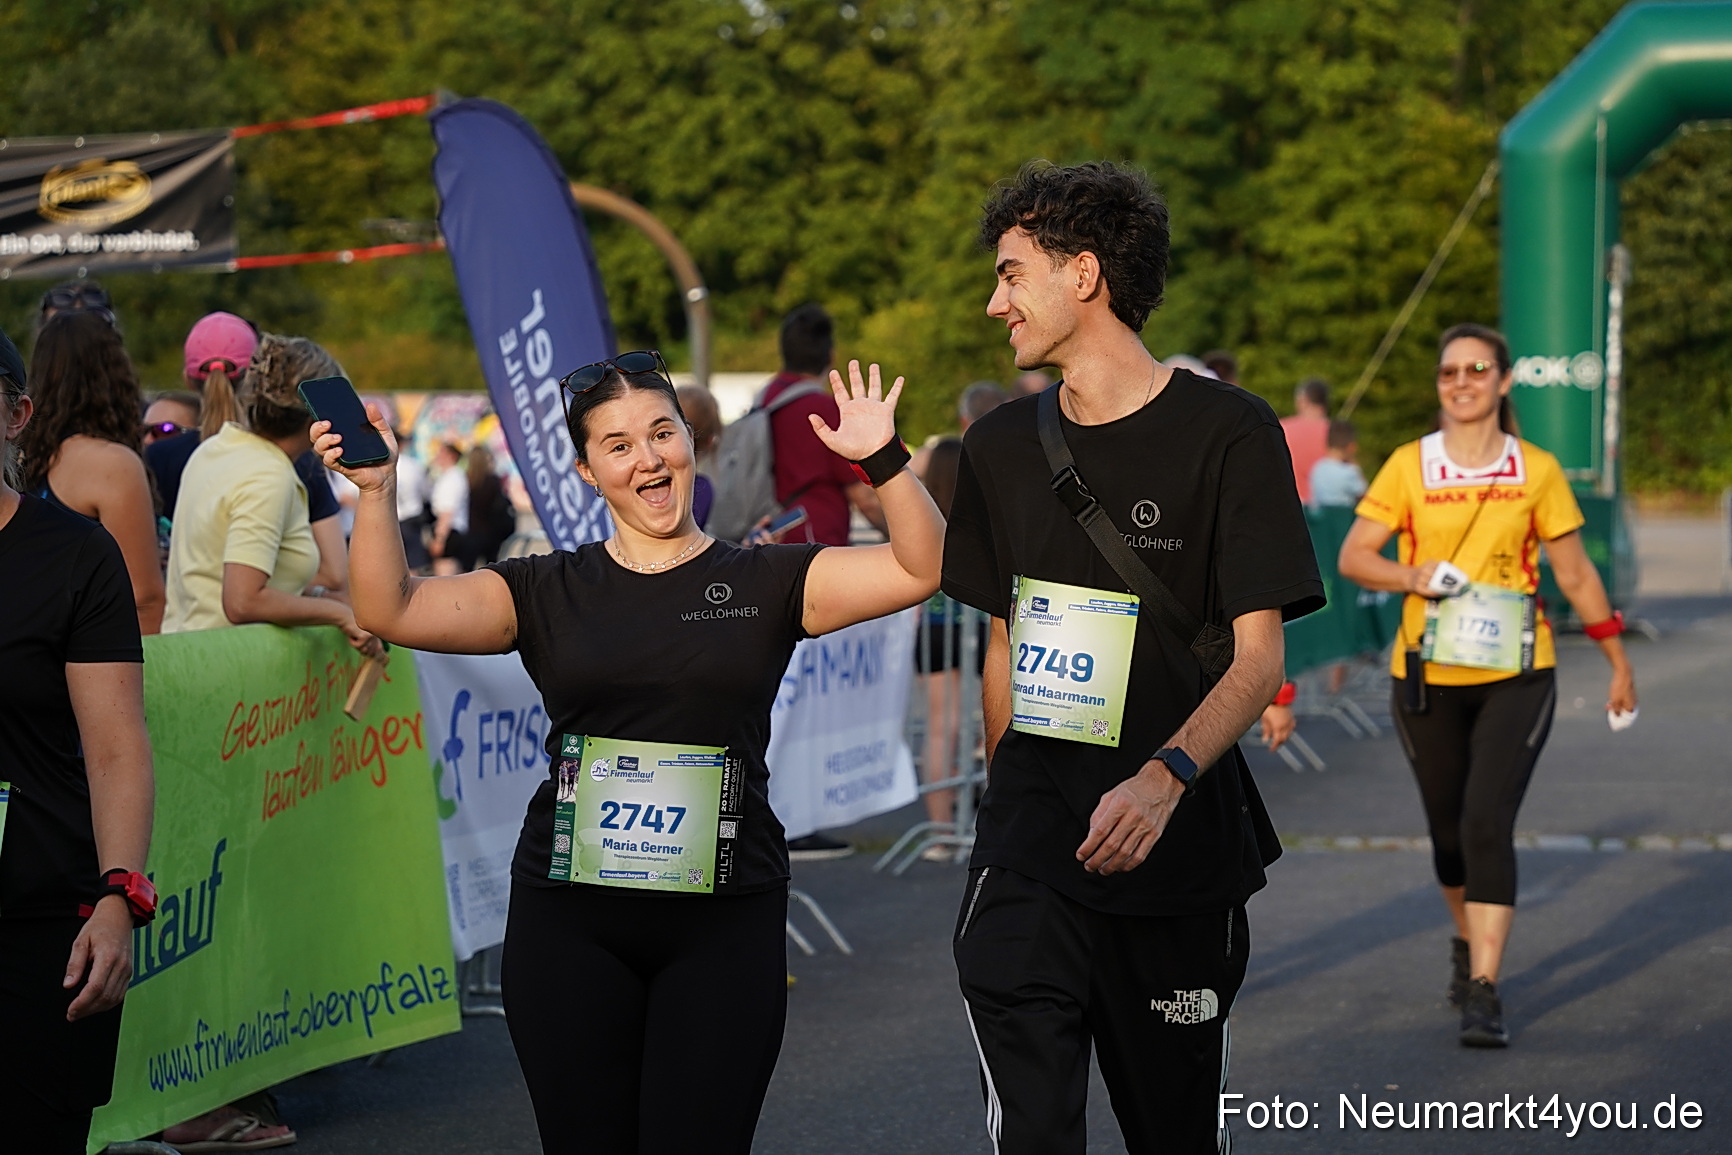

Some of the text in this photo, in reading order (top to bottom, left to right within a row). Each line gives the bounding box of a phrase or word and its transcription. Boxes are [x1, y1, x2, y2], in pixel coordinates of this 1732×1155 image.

[680, 606, 759, 622] WEGLÖHNER
[1026, 610, 1064, 622] Firmenlauf
[1459, 616, 1499, 636] 1775
[1017, 642, 1094, 683] 2749
[1037, 685, 1106, 707] Haarmann
[221, 660, 321, 762] Gesunde
[563, 745, 581, 754] AOK
[262, 712, 423, 822] laufen länger
[610, 769, 655, 779] Firmenlauf
[723, 757, 732, 791] RABATT
[731, 758, 739, 784] OUTLET
[721, 800, 728, 812] 20
[600, 801, 687, 834] 2747
[602, 838, 684, 855] Maria Gerner
[719, 842, 730, 884] HILTL
[1173, 989, 1201, 1002] THE
[1151, 998, 1200, 1013] NORTH
[1164, 1011, 1200, 1025] FACE
